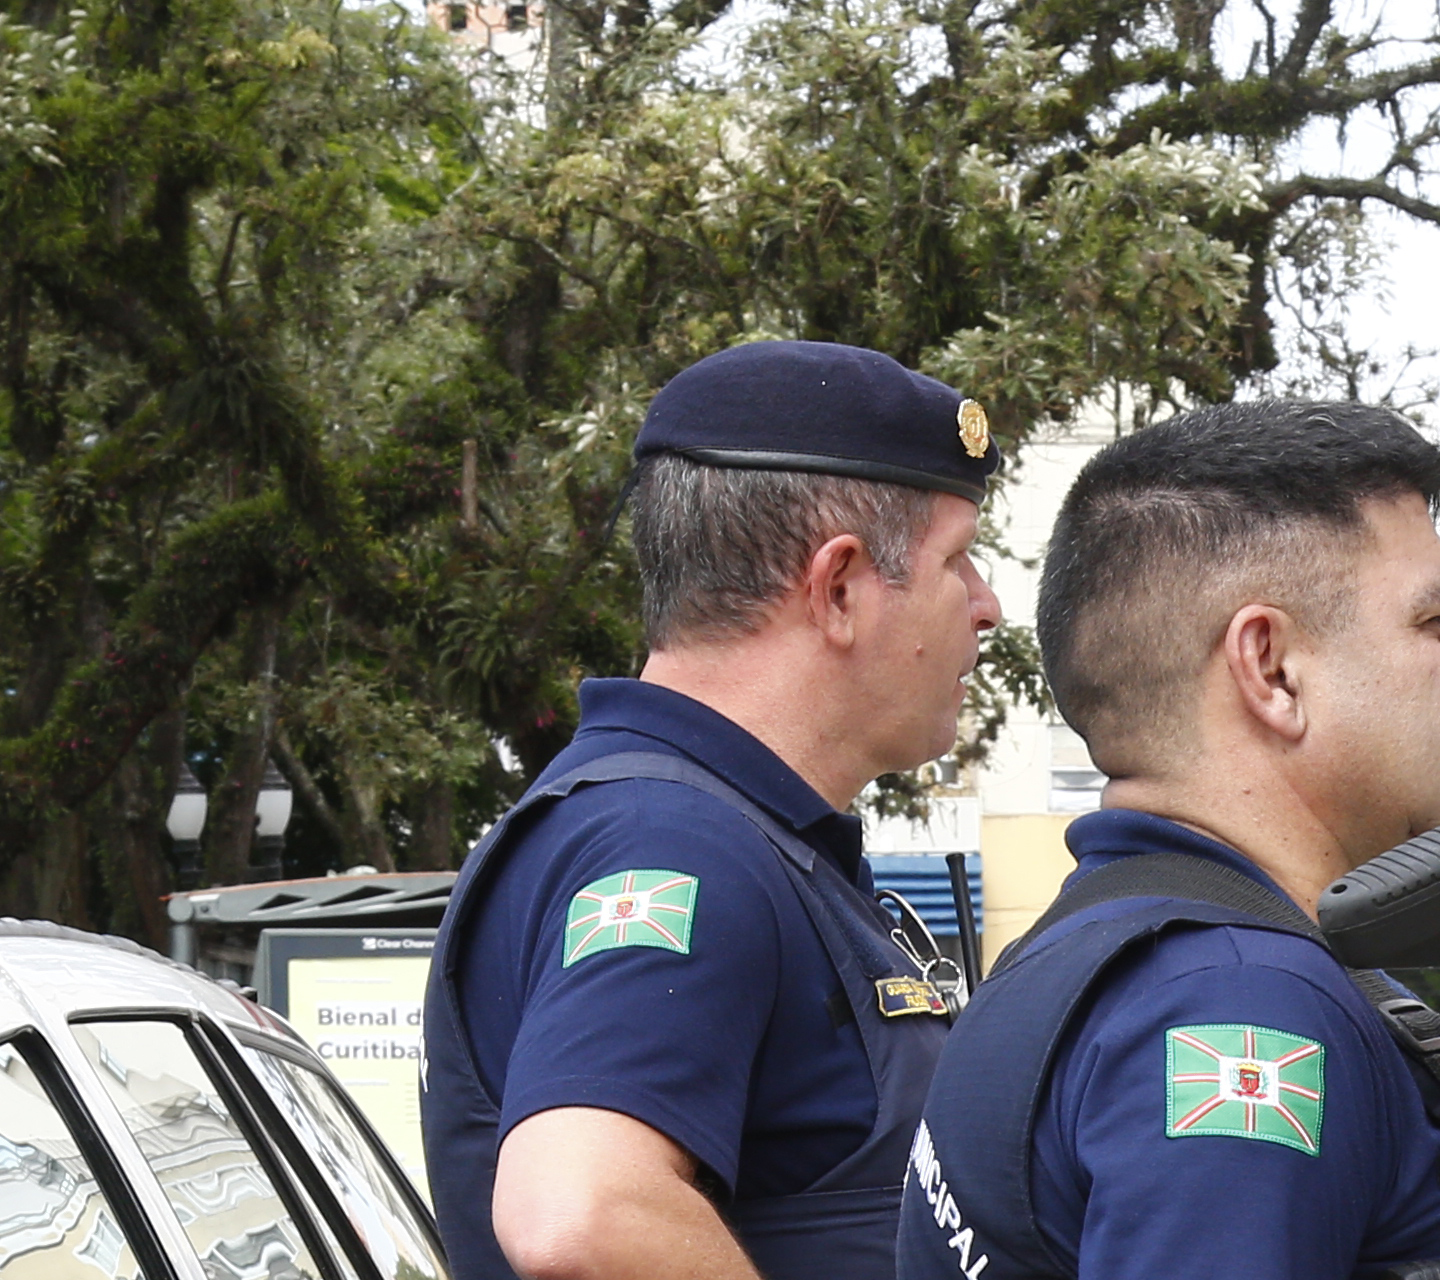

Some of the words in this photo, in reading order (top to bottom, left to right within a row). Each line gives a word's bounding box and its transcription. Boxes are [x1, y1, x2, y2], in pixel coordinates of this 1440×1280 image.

[376, 938, 401, 949] Clear
[318, 1007, 397, 1026] Bienal
[406, 1007, 422, 1026] d
[317, 1041, 421, 1060] Curitiba
